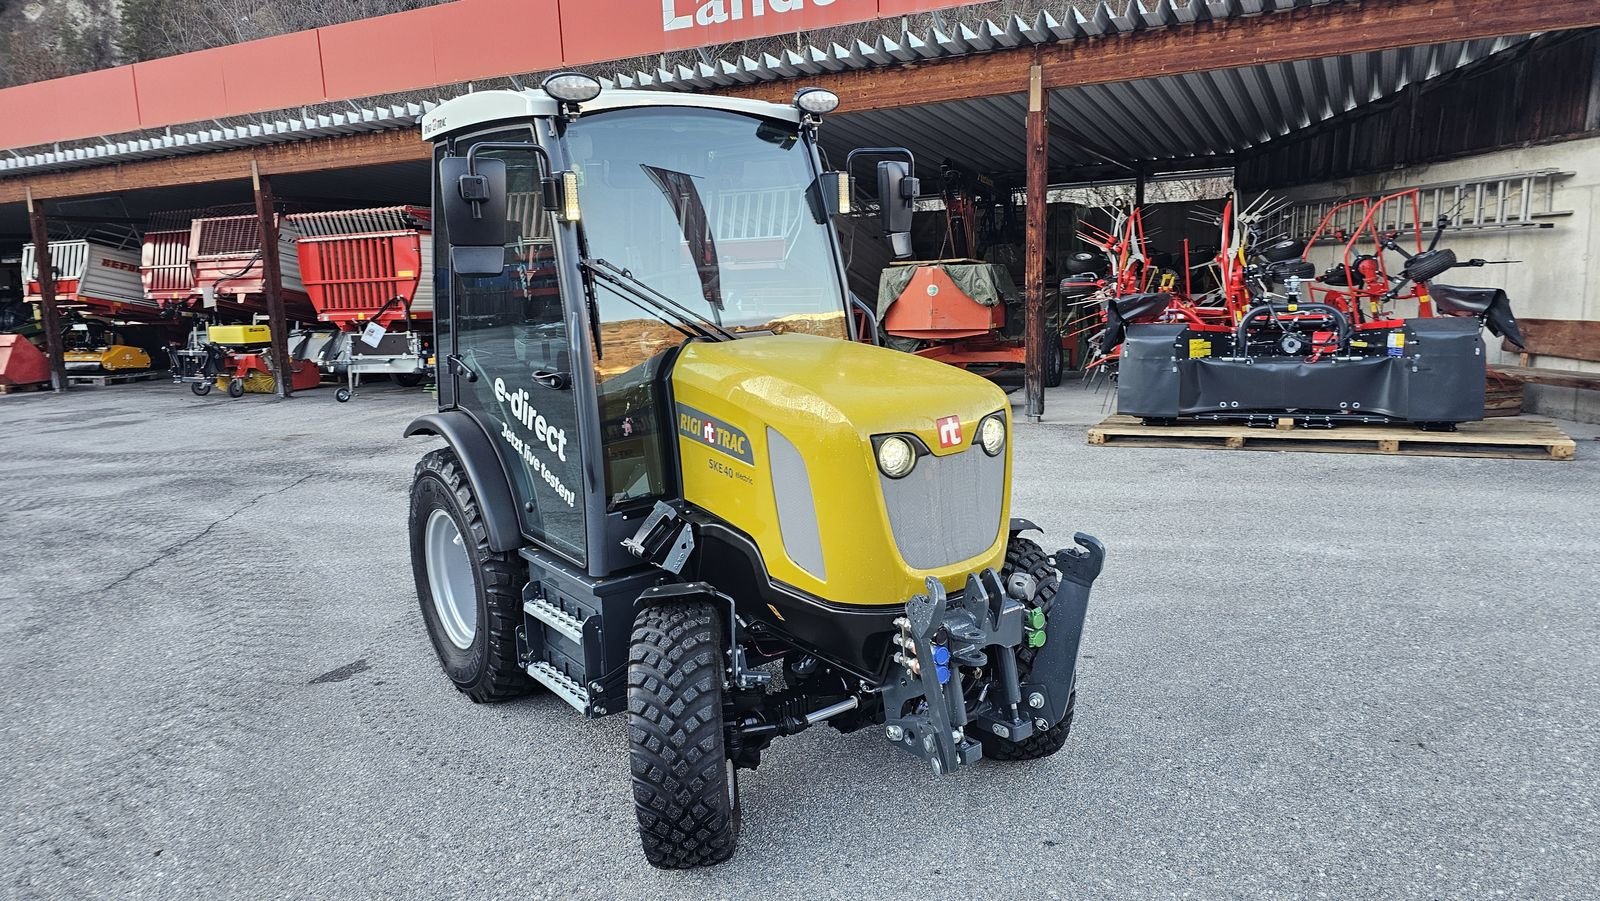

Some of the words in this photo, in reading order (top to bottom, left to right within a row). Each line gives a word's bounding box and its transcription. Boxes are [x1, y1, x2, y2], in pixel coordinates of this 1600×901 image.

[663, 0, 838, 31] Lan
[494, 377, 567, 462] e-direct
[680, 413, 701, 435] RIGI
[716, 427, 745, 454] TRAC
[500, 421, 523, 455] Jetzt
[523, 443, 540, 472] live
[540, 462, 576, 508] testen!
[709, 458, 722, 474] SKE
[724, 466, 734, 479] 40
